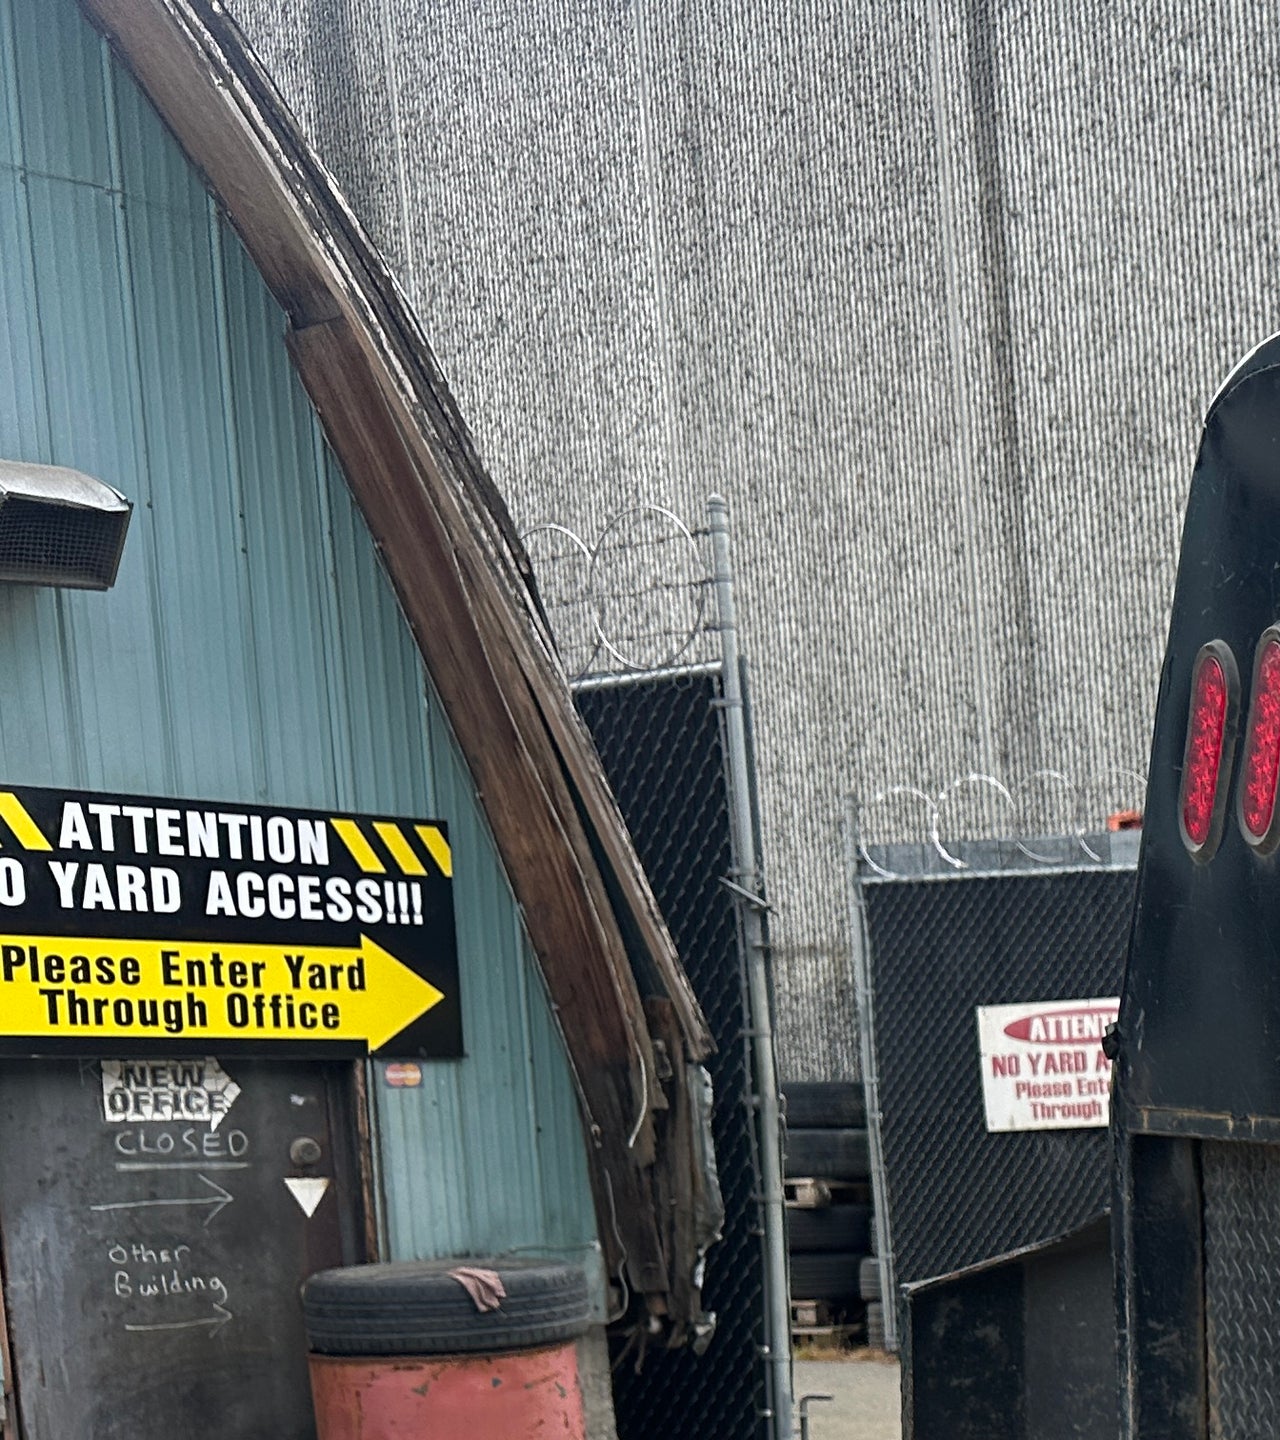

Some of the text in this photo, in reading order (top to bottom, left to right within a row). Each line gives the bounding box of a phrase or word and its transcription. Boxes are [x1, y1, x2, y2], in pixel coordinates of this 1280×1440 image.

[59, 801, 330, 866] ATTENTION
[49, 860, 182, 914] YARD
[205, 870, 424, 925] ACCESS!!!
[2, 944, 366, 991] Please Enter Yard
[39, 988, 341, 1033] Through Office
[124, 1065, 203, 1088] NEW
[992, 1053, 1020, 1078] NO
[1027, 1050, 1088, 1076] YARD
[108, 1087, 228, 1115] OFFICE
[1015, 1080, 1073, 1099] Please
[1030, 1099, 1102, 1121] Through
[115, 1127, 249, 1157] CLOSED
[108, 1244, 191, 1265] Other
[114, 1270, 228, 1305] Building
